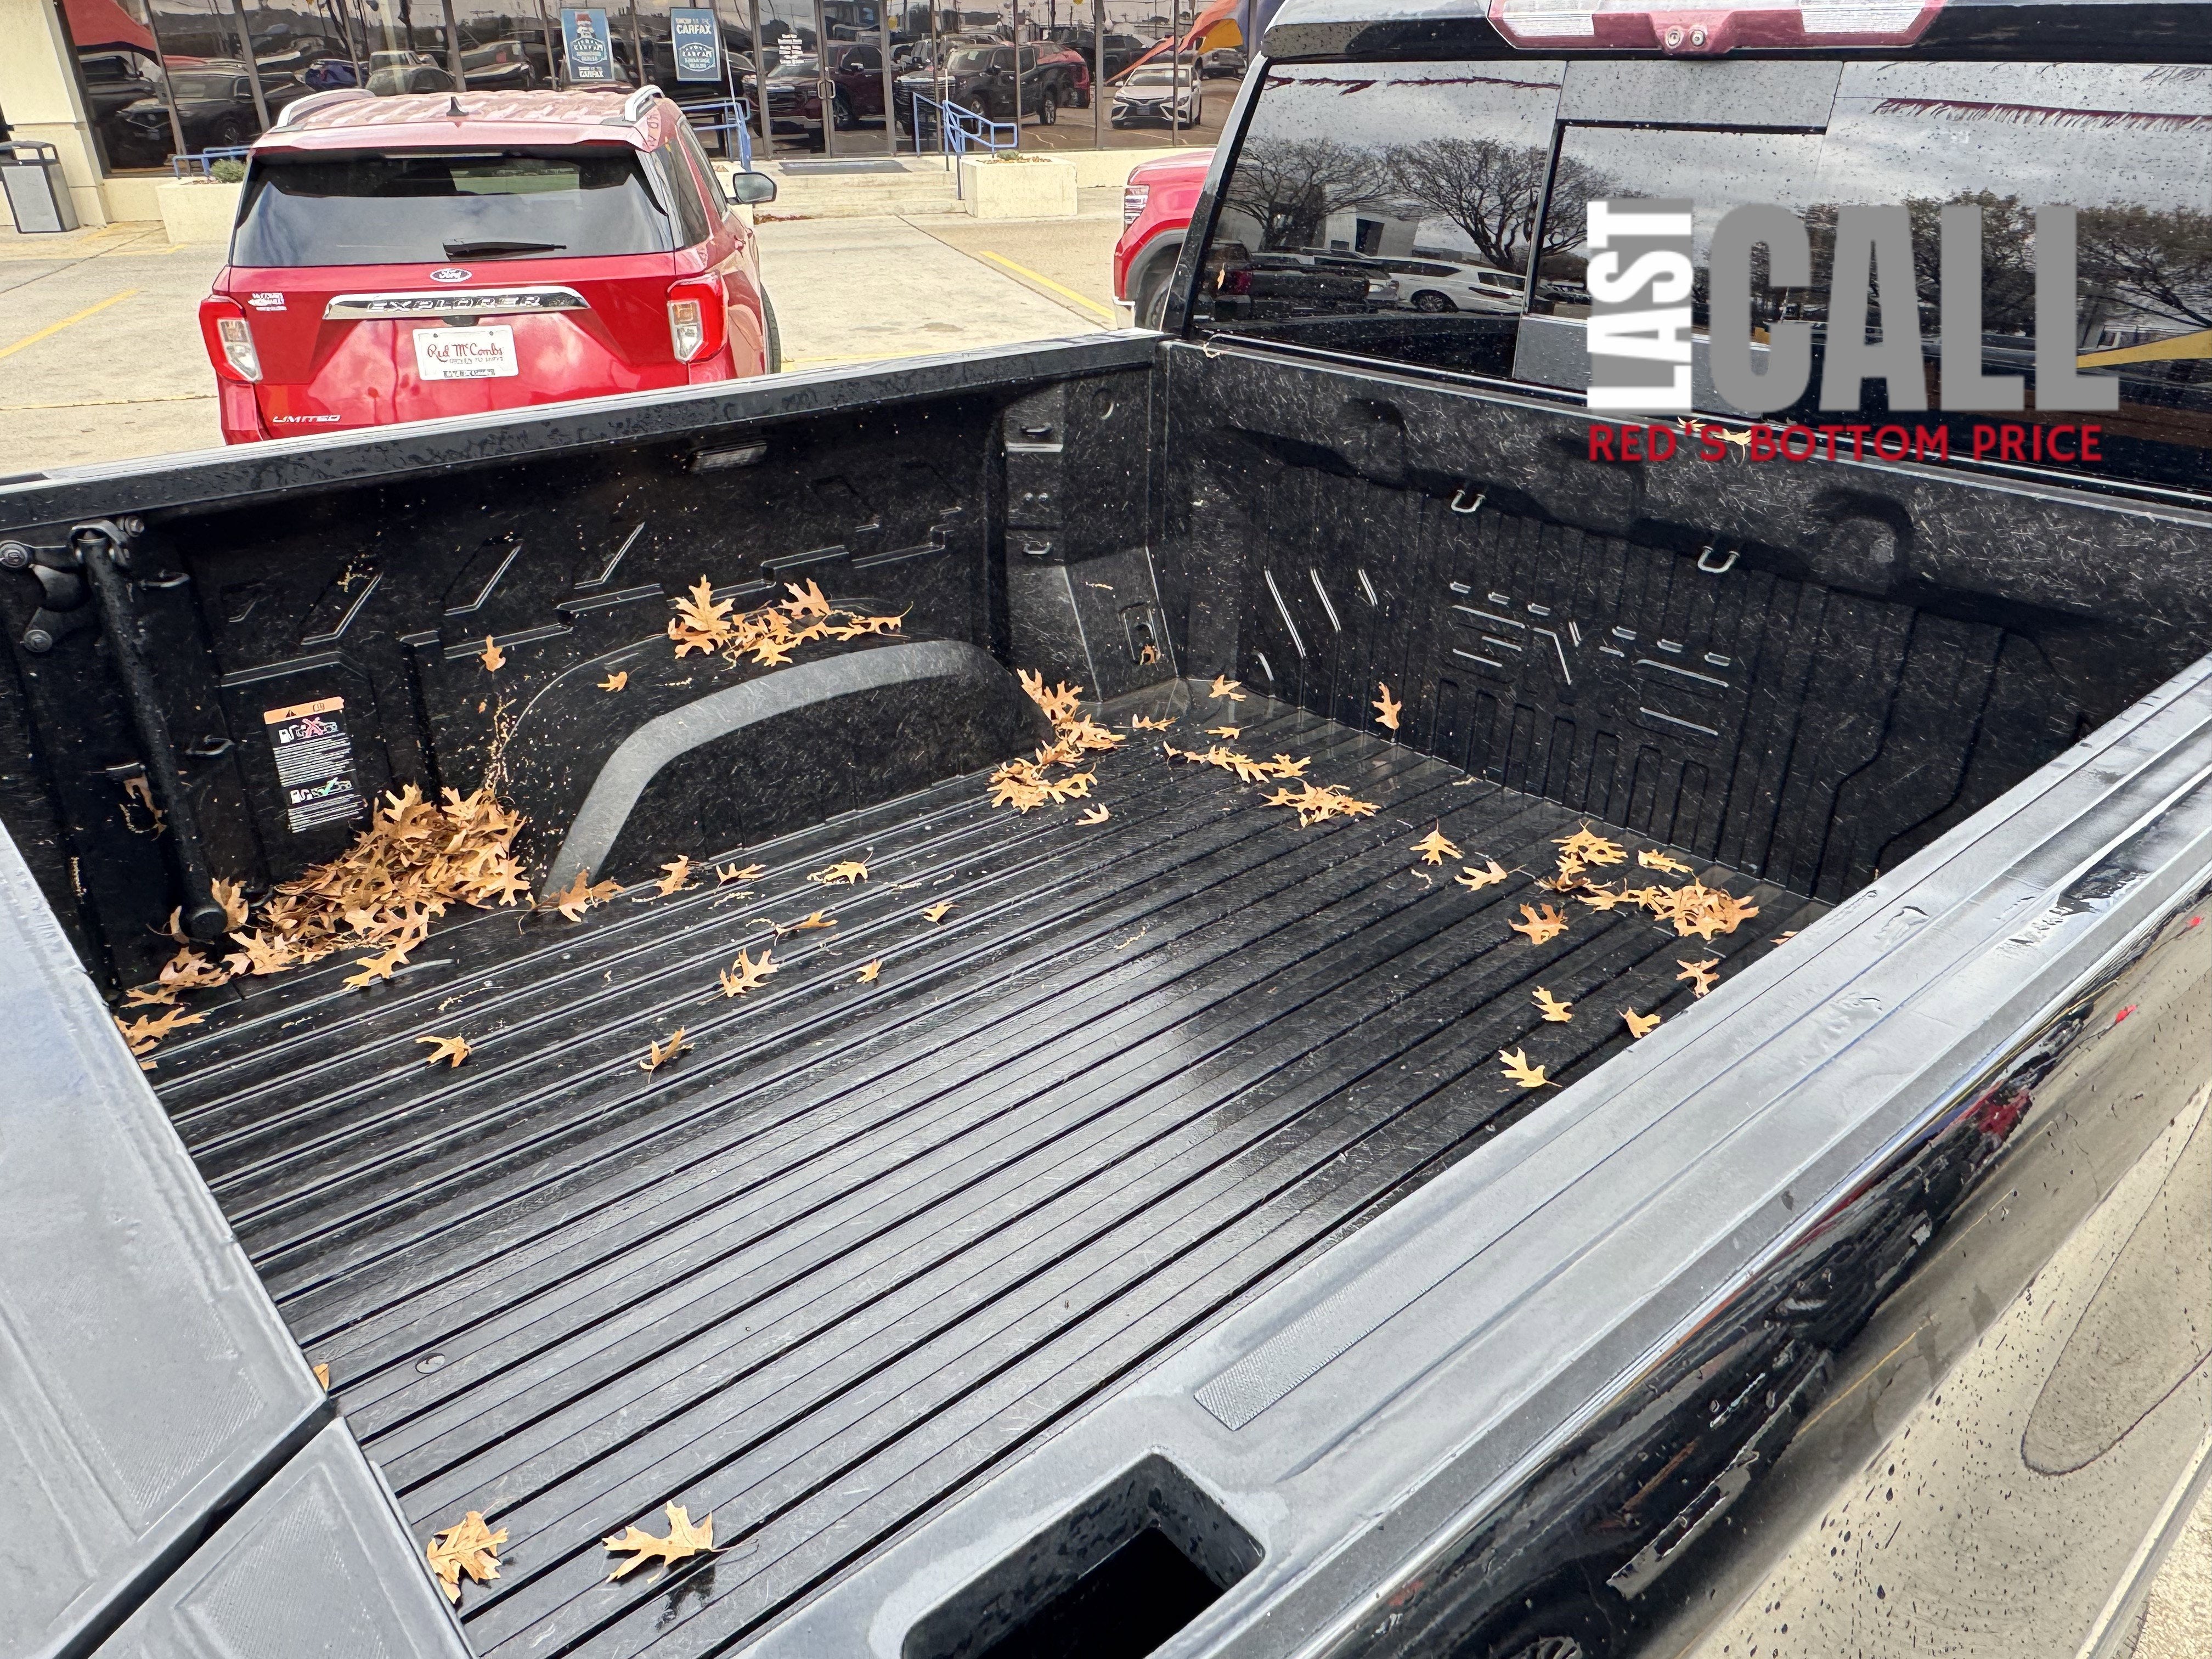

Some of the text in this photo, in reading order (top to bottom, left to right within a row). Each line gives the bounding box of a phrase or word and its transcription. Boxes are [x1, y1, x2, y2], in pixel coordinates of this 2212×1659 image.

[676, 24, 712, 35] CARFAX
[366, 296, 543, 313] EXPLORER
[272, 415, 341, 423] LIMITED
